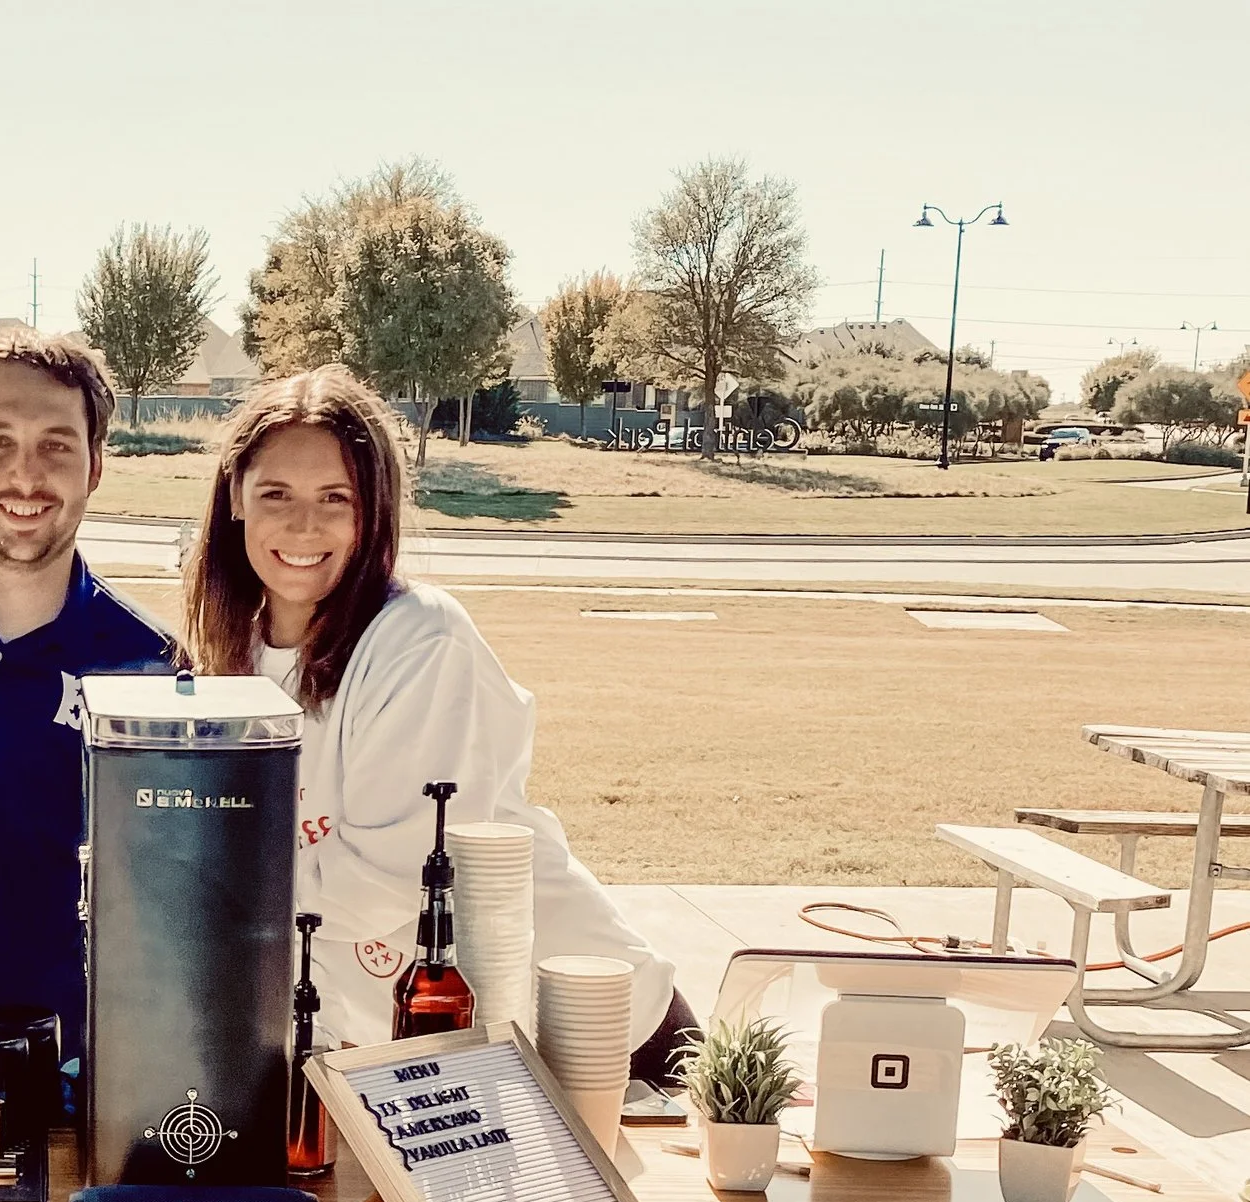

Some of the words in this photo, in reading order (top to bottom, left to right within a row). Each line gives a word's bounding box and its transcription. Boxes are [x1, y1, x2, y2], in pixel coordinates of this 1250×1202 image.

[393, 1062, 441, 1083] MENU
[377, 1099, 402, 1117] TX
[406, 1086, 470, 1111] DELIGHT
[406, 1137, 474, 1163] VANILLA
